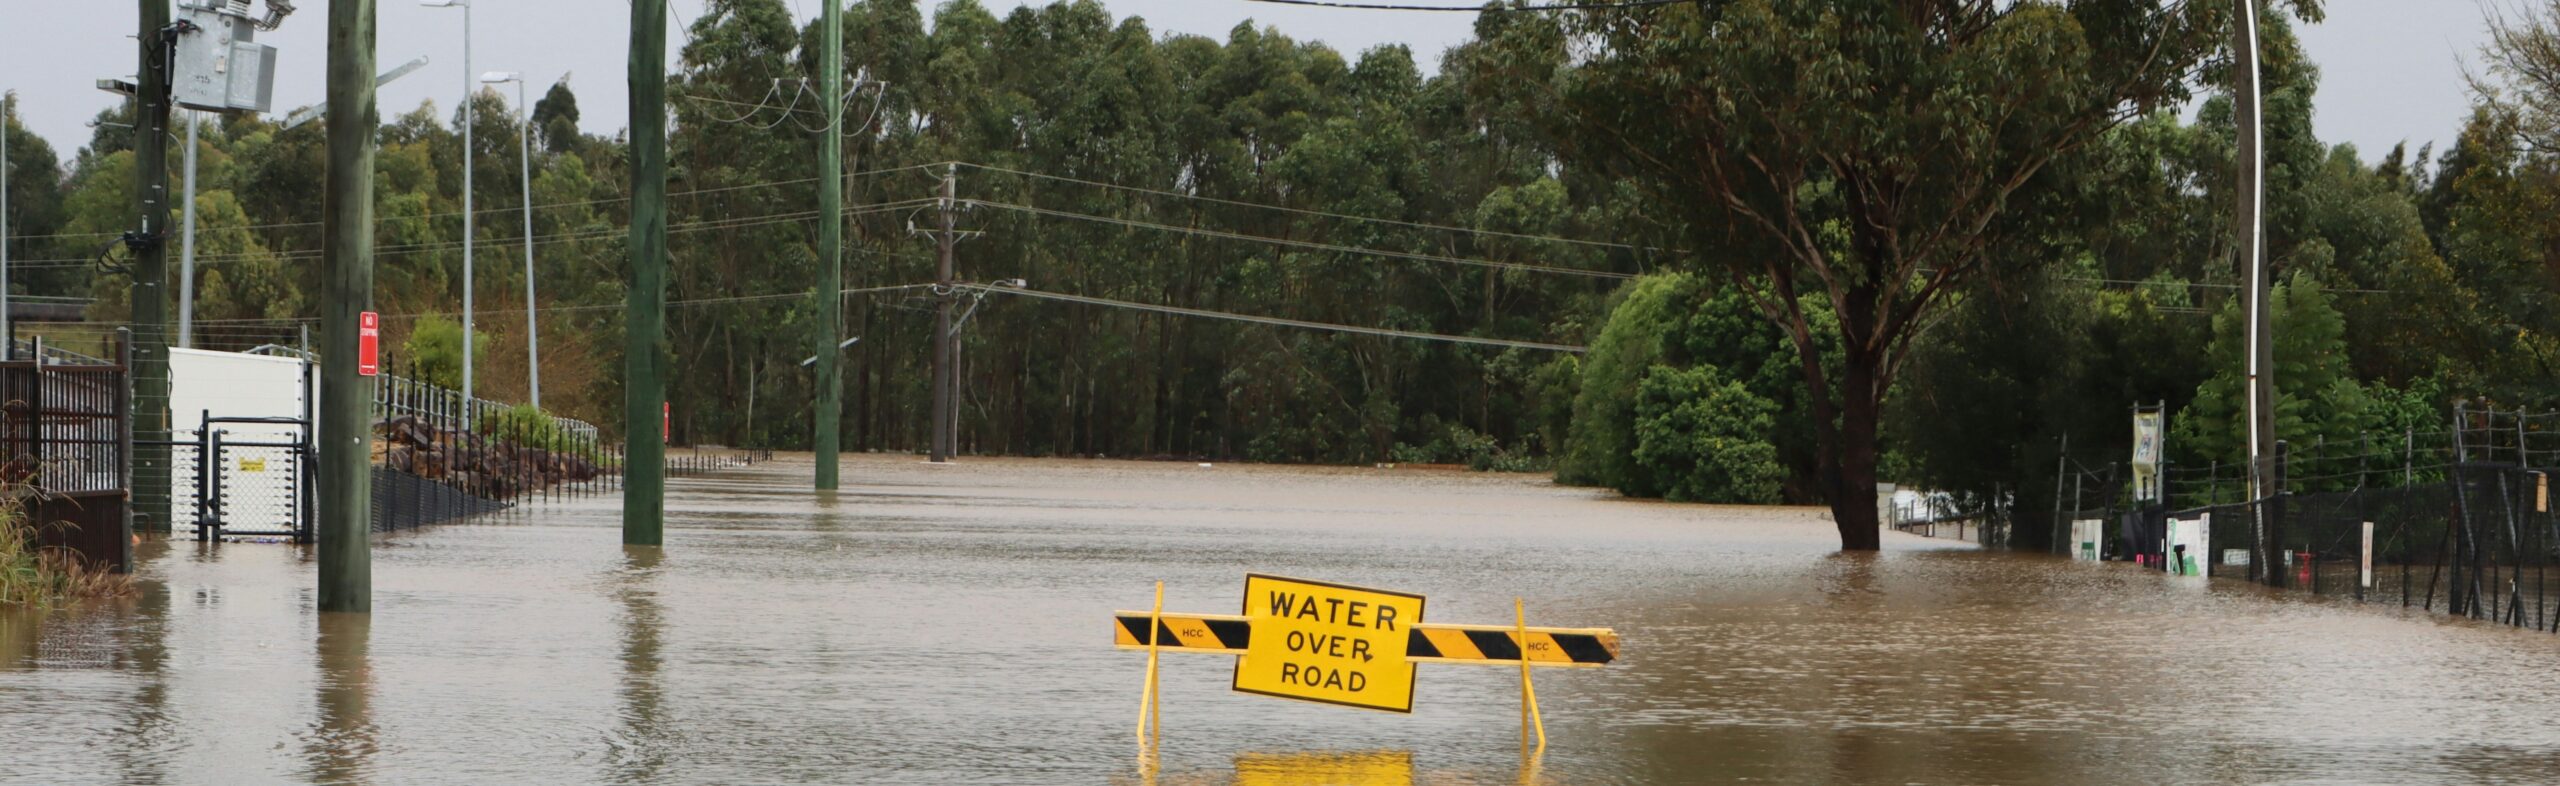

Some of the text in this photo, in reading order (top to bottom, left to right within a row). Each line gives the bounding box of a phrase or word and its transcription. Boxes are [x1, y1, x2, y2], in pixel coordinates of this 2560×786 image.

[1270, 590, 1398, 632] WATER
[1182, 628, 1203, 638] HCC
[1286, 630, 1372, 662] OVER
[1528, 642, 1549, 651] HCC
[1281, 662, 1366, 692] ROAD
